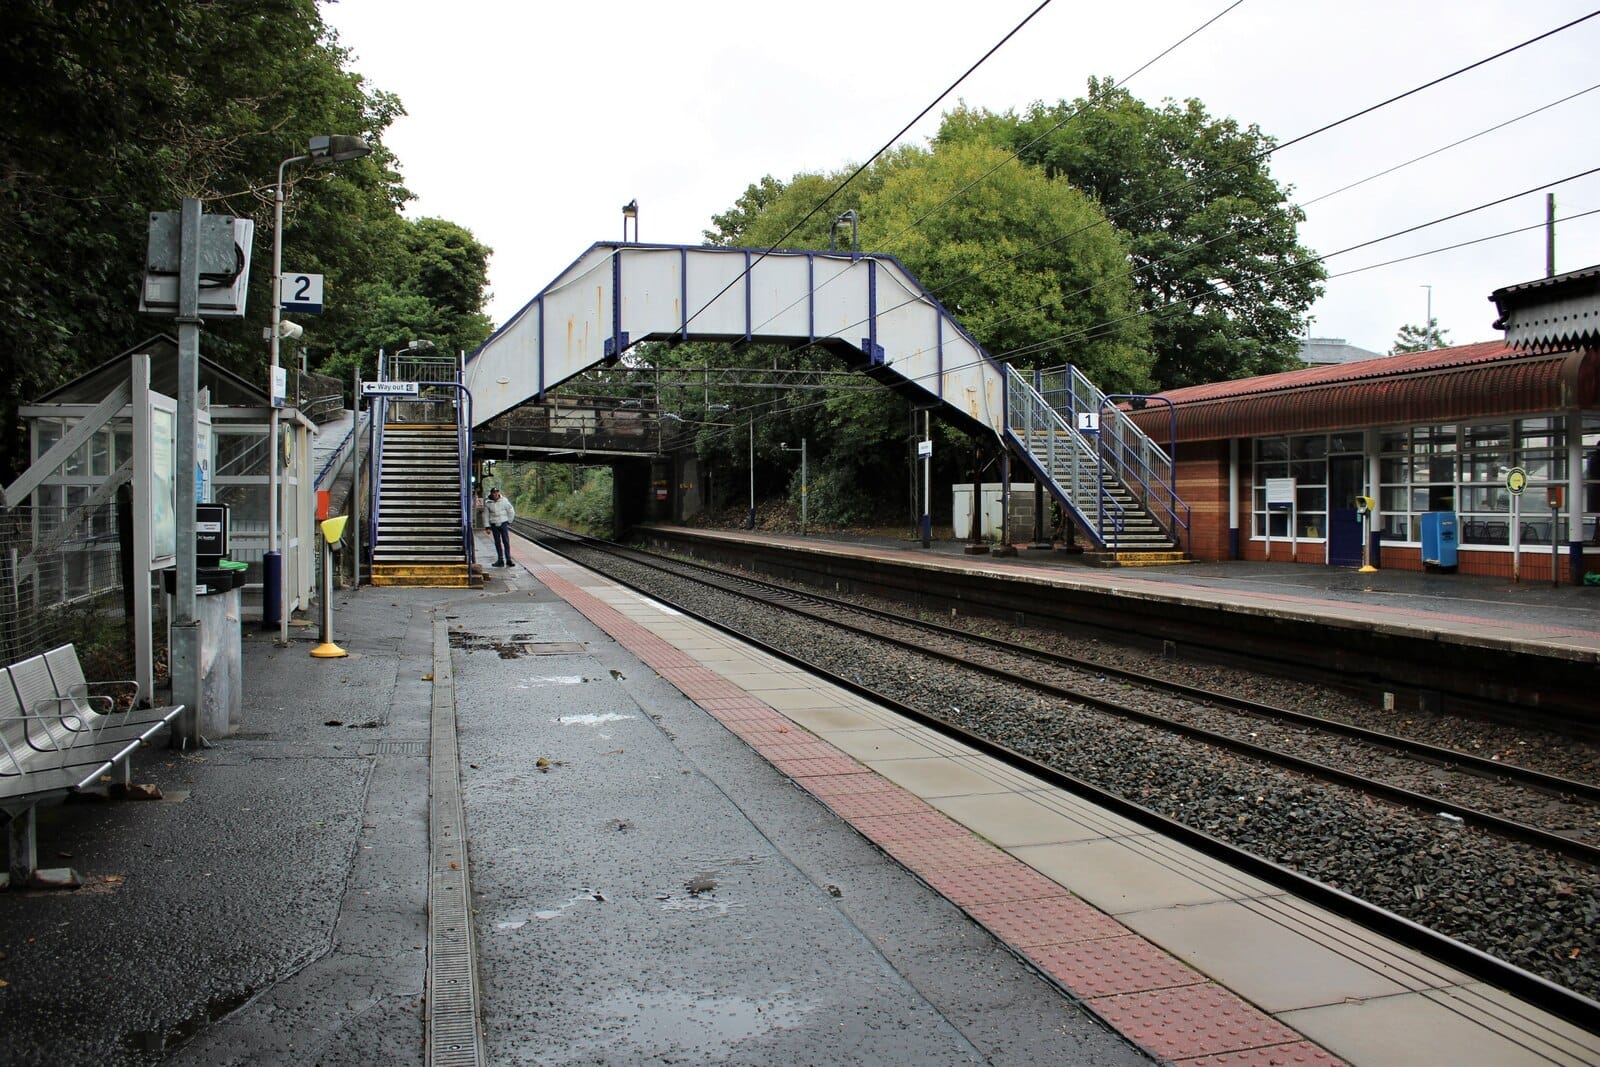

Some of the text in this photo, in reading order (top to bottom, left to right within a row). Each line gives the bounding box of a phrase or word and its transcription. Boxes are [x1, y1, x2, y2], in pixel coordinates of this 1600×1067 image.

[294, 275, 311, 301] 2
[377, 383, 391, 391] Way
[1085, 414, 1093, 428] 1
